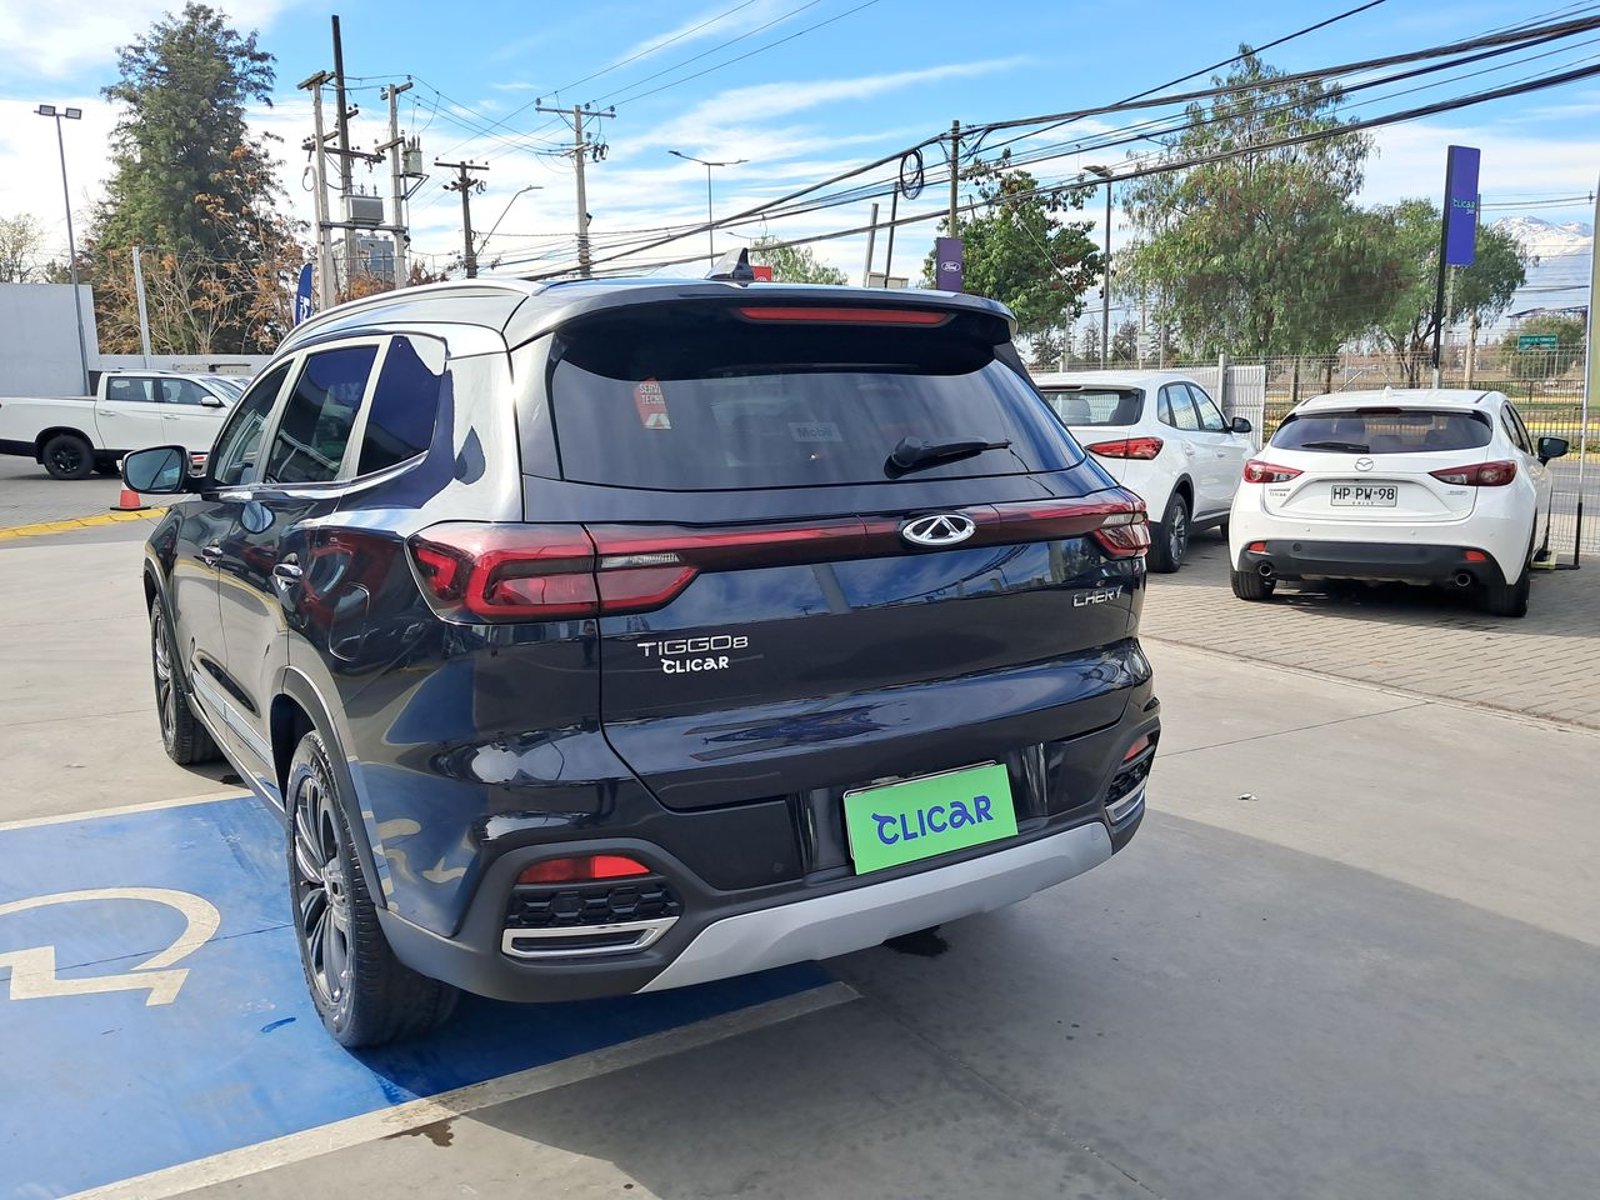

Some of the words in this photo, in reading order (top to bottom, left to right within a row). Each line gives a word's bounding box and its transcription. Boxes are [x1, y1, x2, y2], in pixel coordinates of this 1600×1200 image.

[1073, 585, 1123, 607] CHERY
[660, 656, 729, 674] CLICAR
[871, 795, 993, 845] CLICAR
